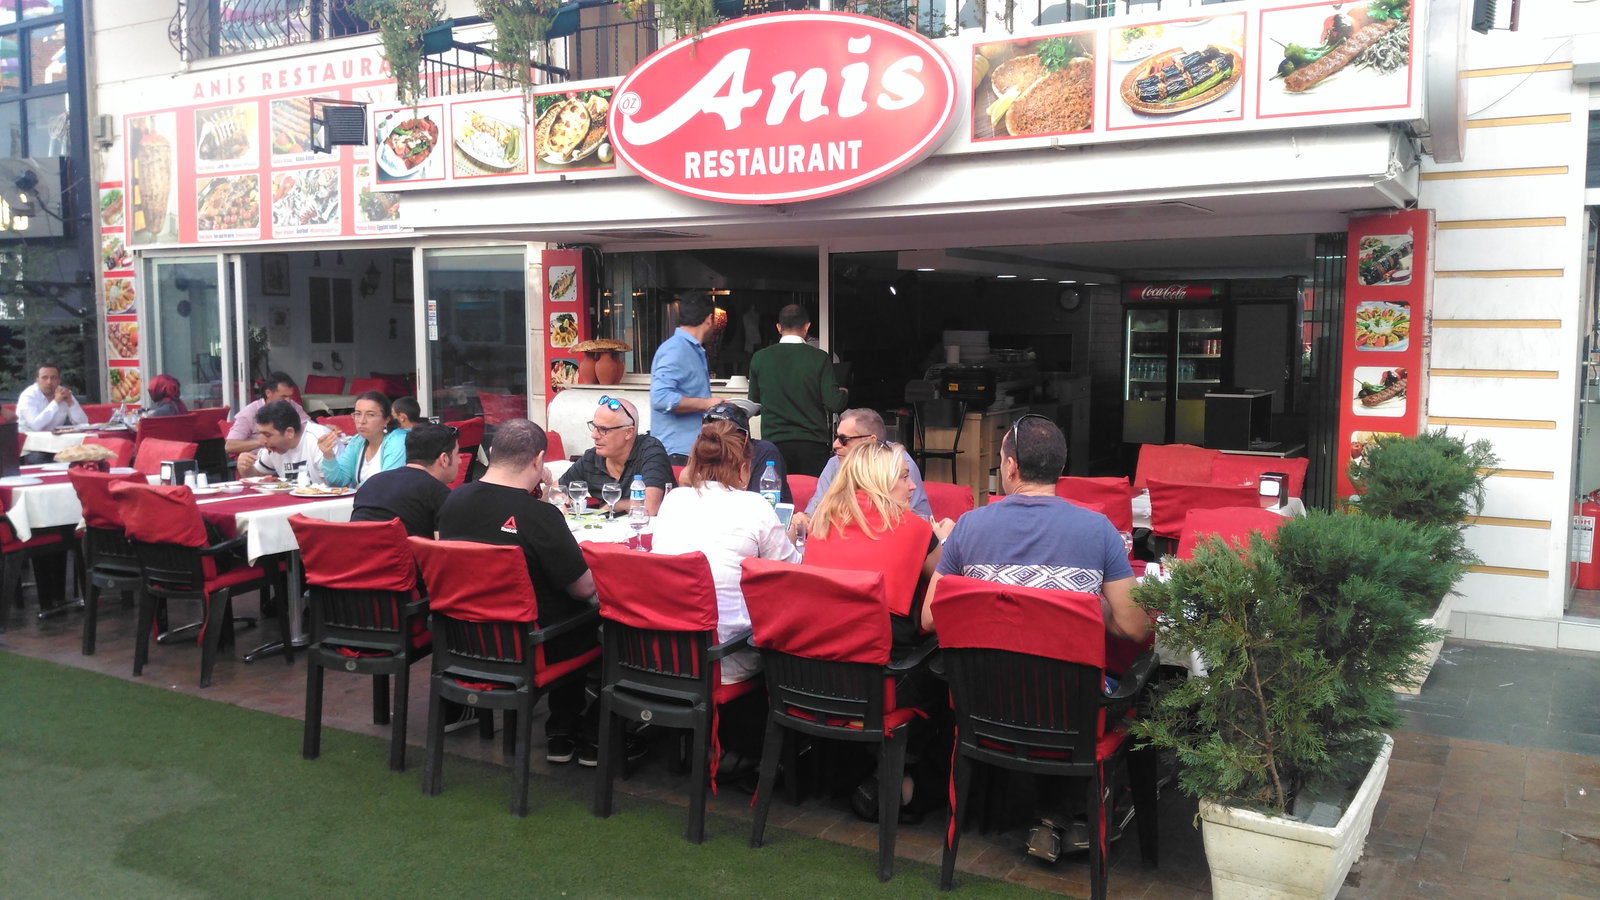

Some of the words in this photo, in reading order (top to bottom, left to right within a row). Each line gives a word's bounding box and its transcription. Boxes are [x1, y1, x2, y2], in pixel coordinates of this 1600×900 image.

[262, 57, 392, 90] RESTAURA
[622, 34, 925, 146] Anis
[622, 96, 637, 110] ÖZ
[684, 139, 863, 179] RESTAURANT
[1141, 284, 1188, 300] Coca-Cola
